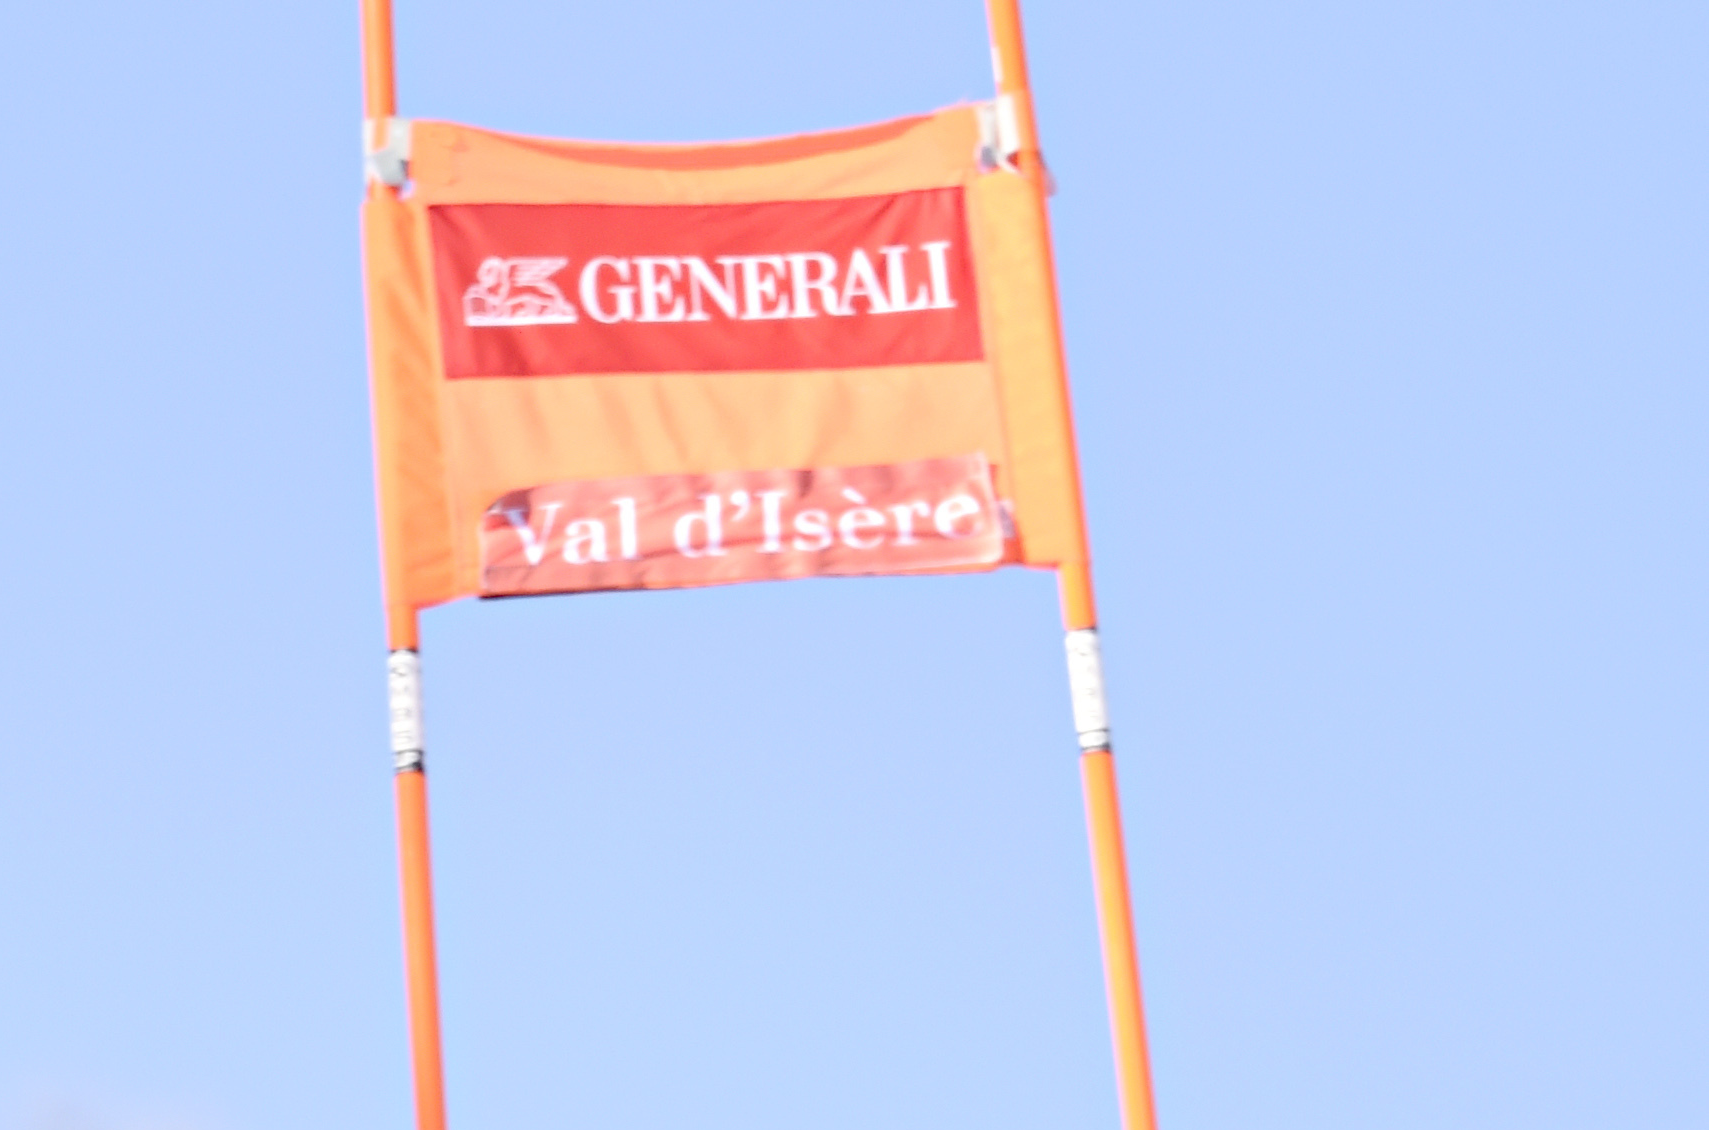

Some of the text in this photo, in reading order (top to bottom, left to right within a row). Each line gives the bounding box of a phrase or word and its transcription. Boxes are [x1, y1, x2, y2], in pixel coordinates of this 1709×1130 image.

[578, 241, 958, 325] GENERALI
[506, 487, 985, 567] Val d'Isère
